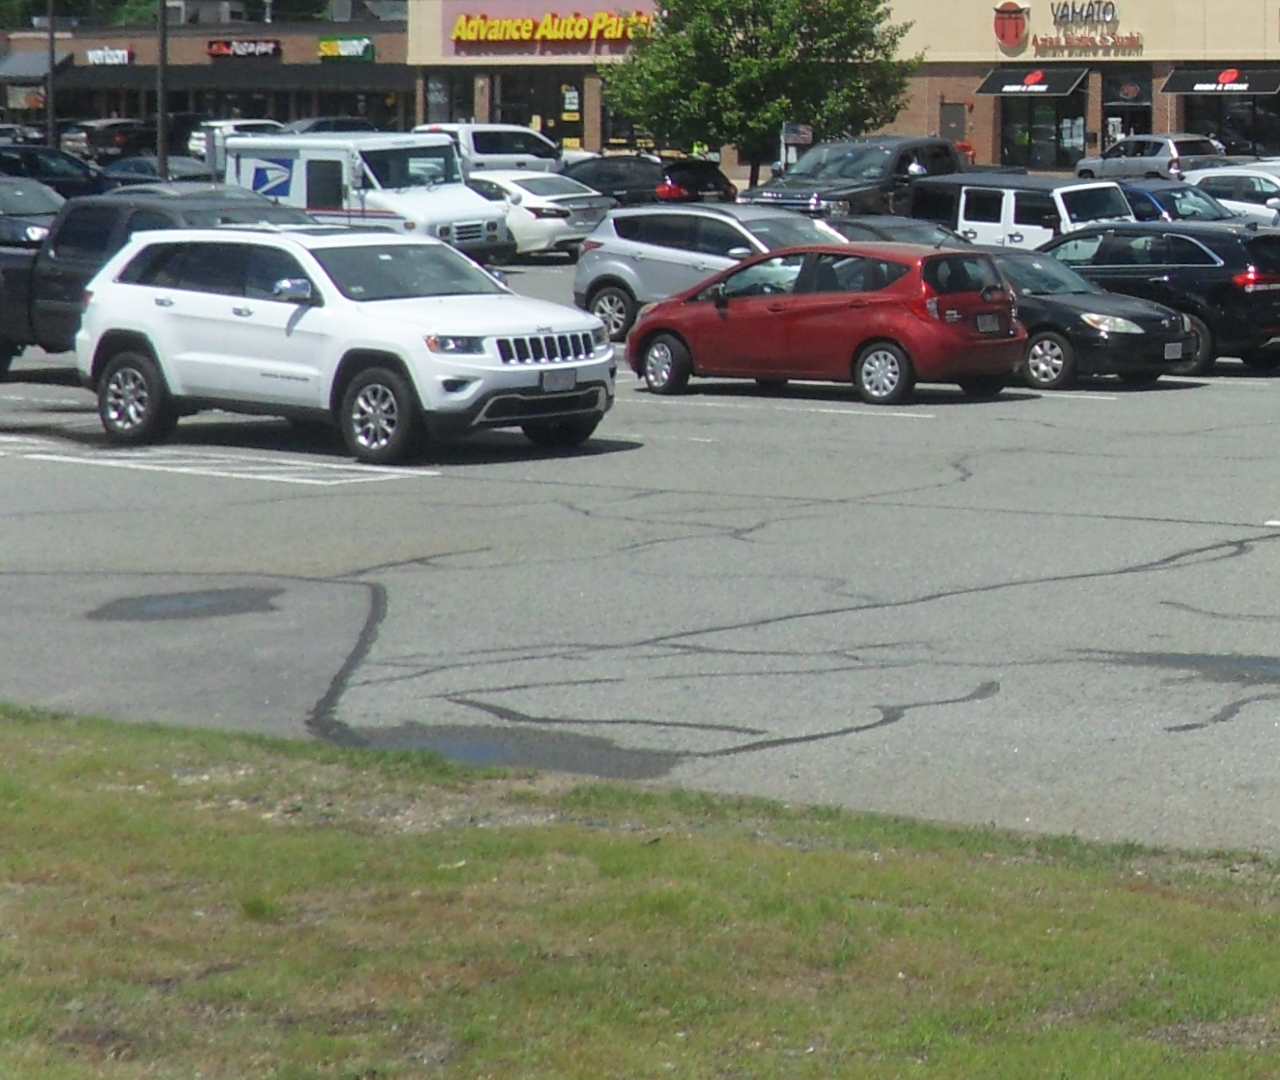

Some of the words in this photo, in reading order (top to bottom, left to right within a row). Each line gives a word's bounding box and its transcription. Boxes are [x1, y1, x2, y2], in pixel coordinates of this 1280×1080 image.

[1050, 0, 1116, 24] YAMATO
[452, 13, 534, 41] Advance
[535, 12, 589, 41] Auto
